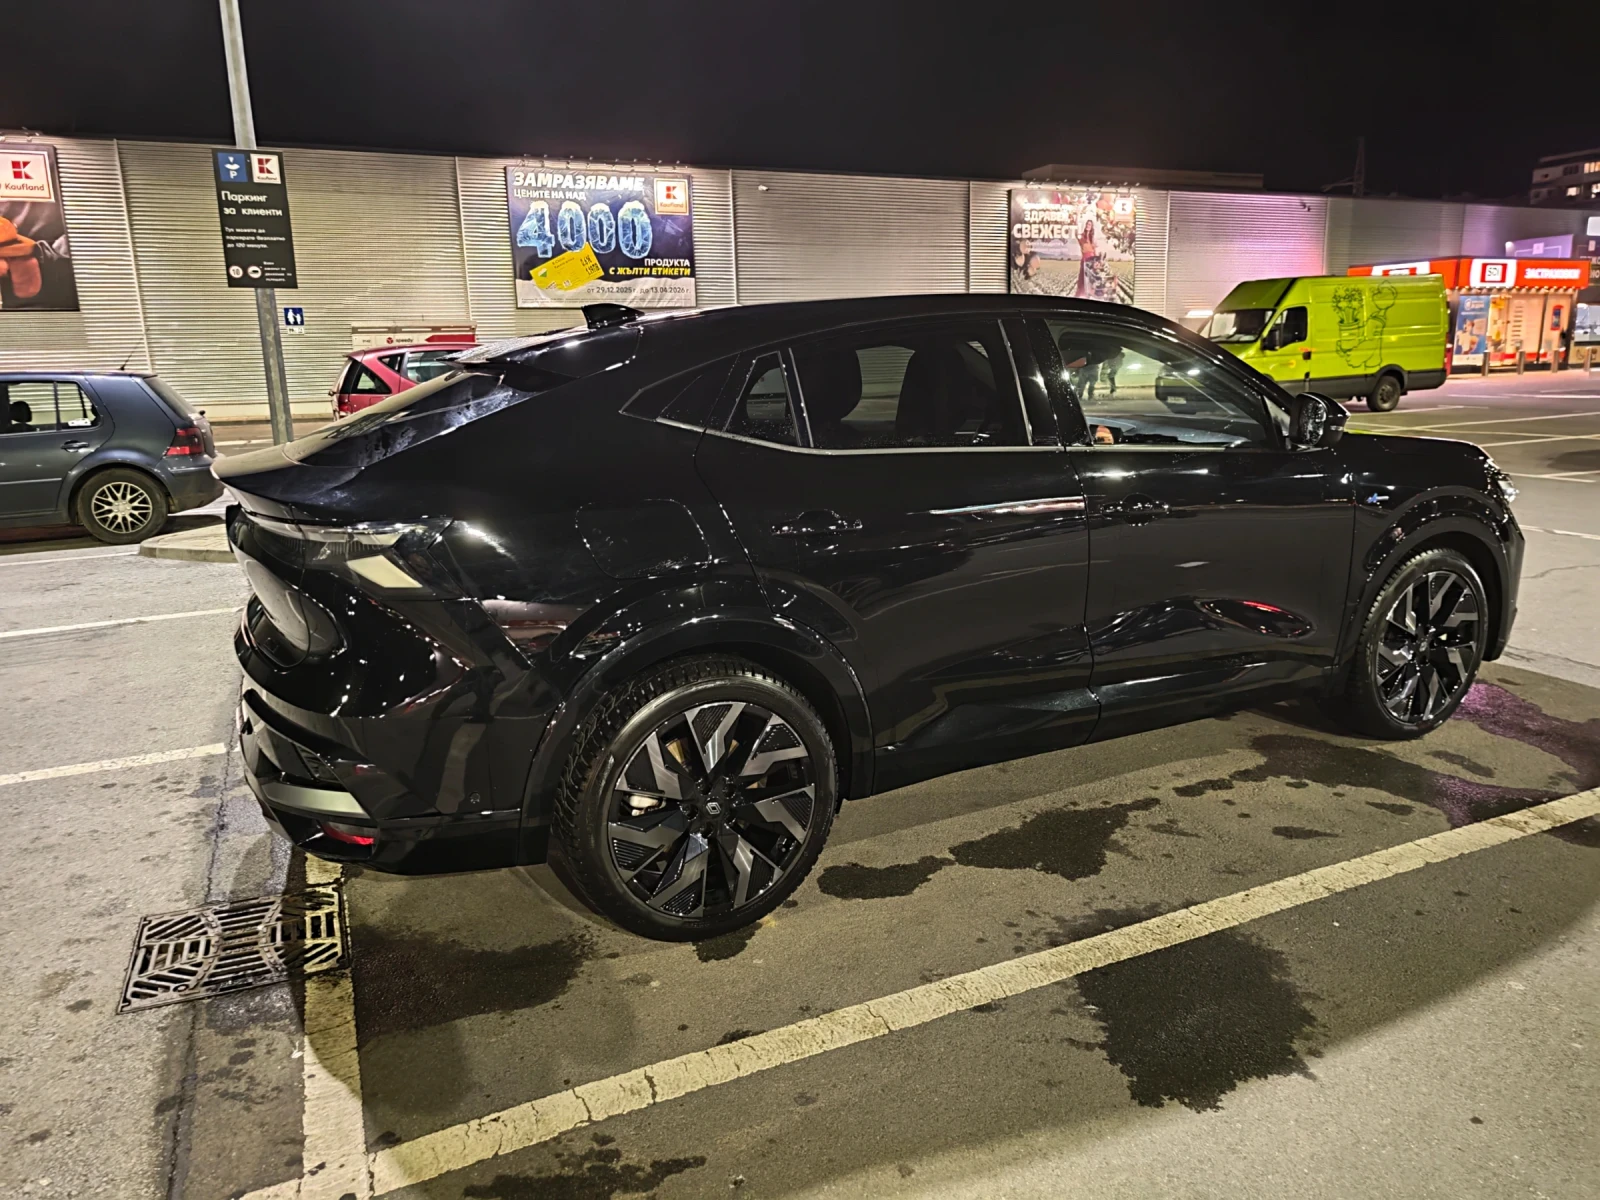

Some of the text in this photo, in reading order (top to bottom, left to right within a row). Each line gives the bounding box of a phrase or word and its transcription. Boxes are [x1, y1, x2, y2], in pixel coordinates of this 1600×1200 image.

[513, 172, 645, 191] ЗАМРАЗЯВАМЕ
[5, 183, 45, 191] Kaufland
[221, 190, 268, 204] Паркинг
[513, 189, 587, 200] ЦЕНИТЕ НА НАД
[223, 207, 283, 216] за клиенти
[516, 200, 653, 259] 4000
[644, 258, 690, 267] ПРОДУКТА
[609, 267, 615, 275] С
[616, 267, 650, 275] ЖЪЛТИ
[651, 268, 691, 276] ЕТИКЕТИ
